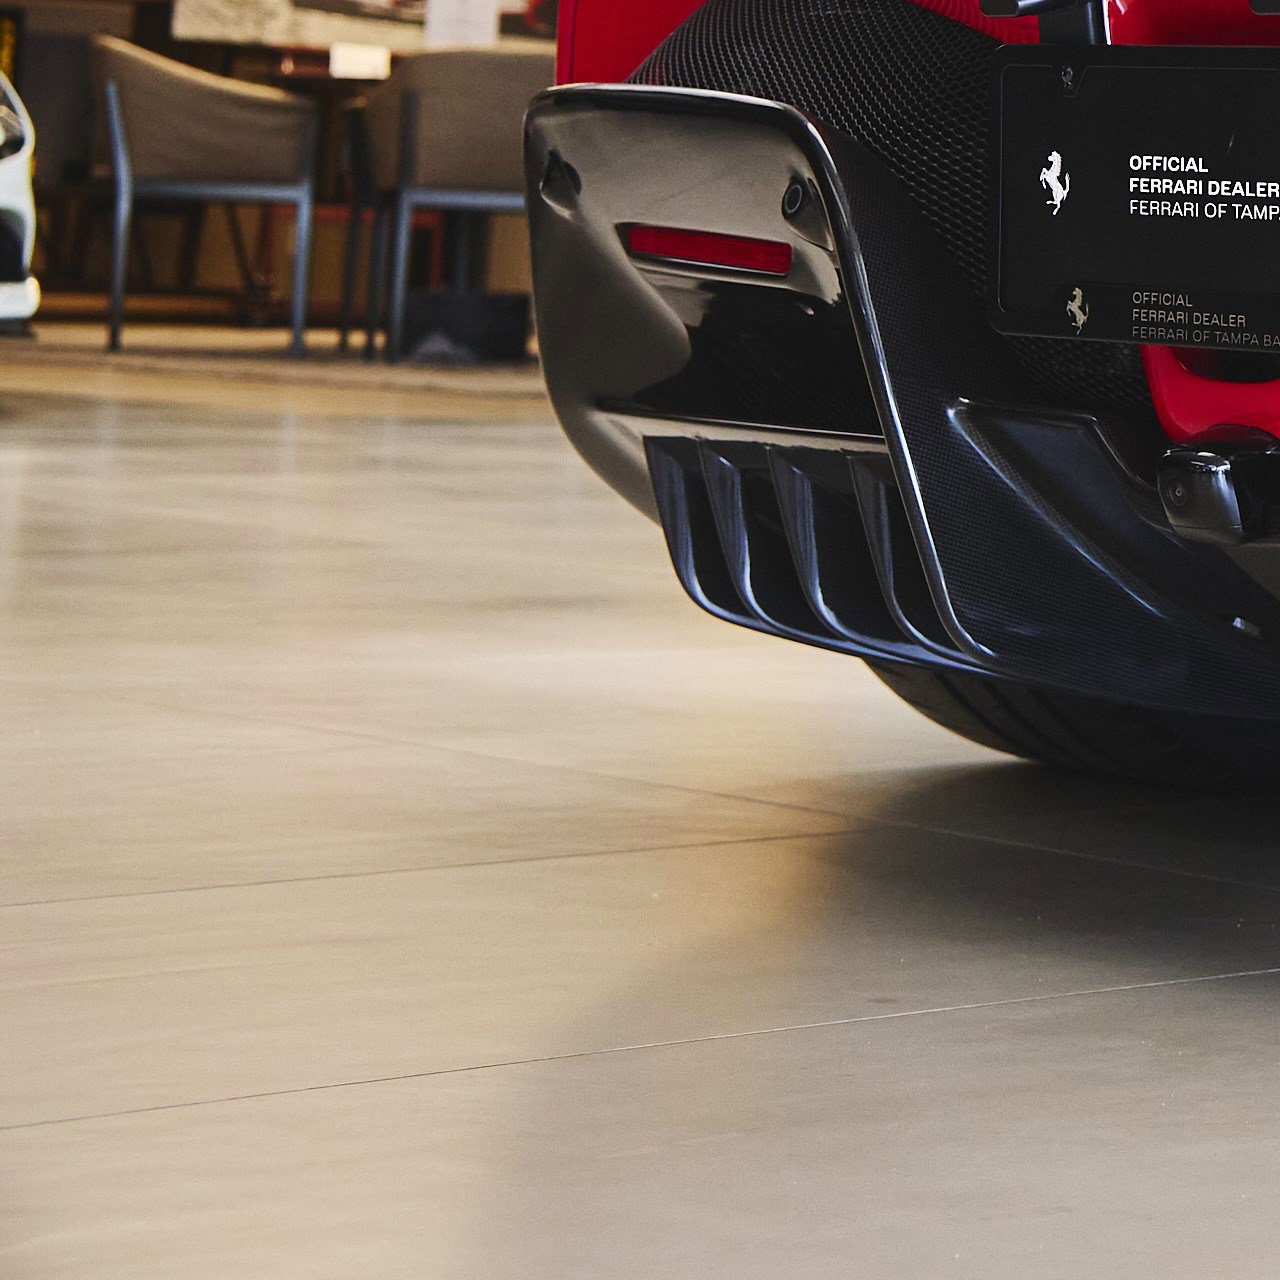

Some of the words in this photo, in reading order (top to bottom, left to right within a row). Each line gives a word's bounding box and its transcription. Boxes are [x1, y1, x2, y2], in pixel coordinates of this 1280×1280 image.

[1129, 154, 1209, 173] OFFICIAL
[1129, 177, 1203, 196] FERRARI
[1207, 180, 1280, 198] DEALER
[1129, 199, 1199, 218] FERRARI
[1203, 202, 1228, 219] OF
[1132, 291, 1194, 307] OFFICIAL
[1132, 308, 1189, 324] FERRARI
[1193, 312, 1246, 328] DEALER
[1132, 326, 1188, 341] FERRARI
[1192, 329, 1210, 343] OF
[1213, 331, 1259, 346] TAMPA
